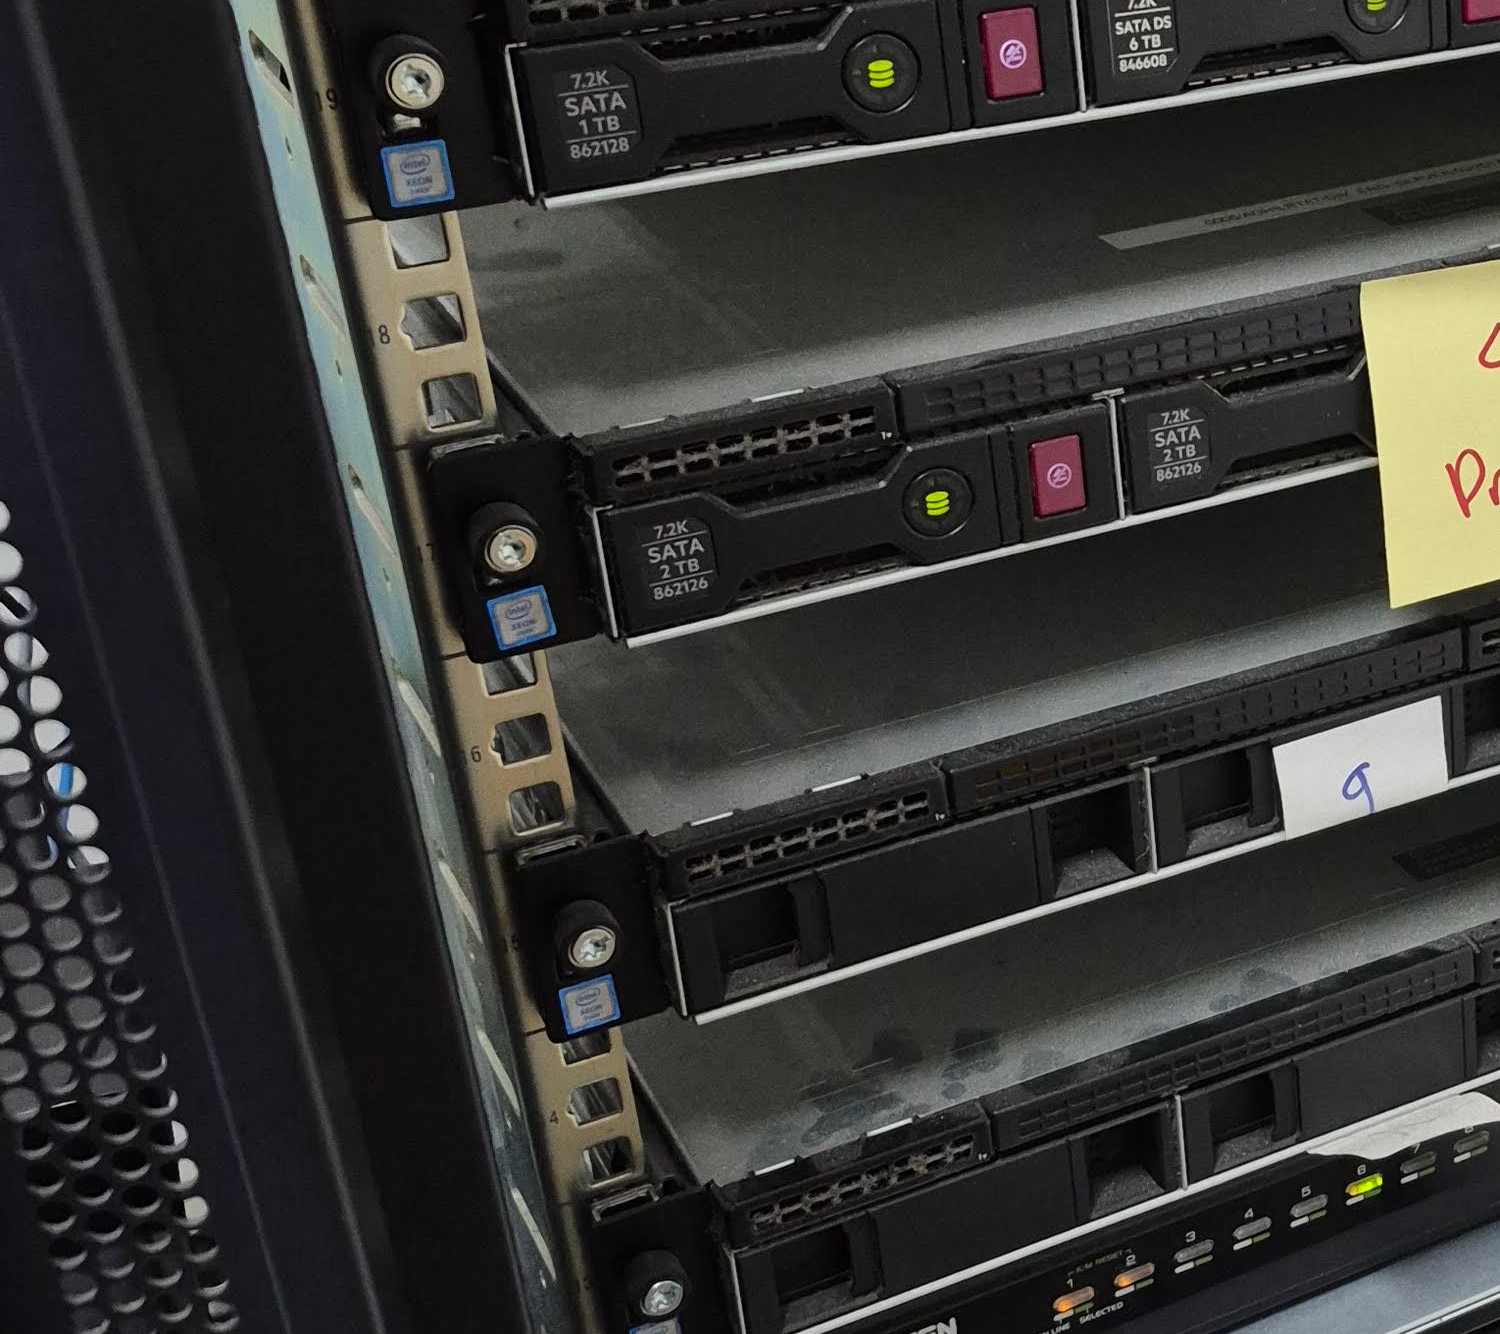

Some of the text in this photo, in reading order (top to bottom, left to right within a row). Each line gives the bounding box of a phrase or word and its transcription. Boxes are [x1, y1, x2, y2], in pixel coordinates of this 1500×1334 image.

[1115, 15, 1172, 35] SATA DS
[1129, 33, 1161, 51] 6 TB
[1119, 54, 1167, 73] 846608
[570, 69, 610, 89] 7.2K
[564, 91, 627, 117] SATA
[578, 115, 621, 135] 1 TB
[569, 137, 630, 159] 862128
[1160, 408, 1191, 425] 7.2K
[1154, 425, 1202, 448] SATA
[1163, 443, 1197, 463] 2 TB
[1156, 461, 1202, 482] 862126
[653, 519, 690, 539] 7.2K
[647, 537, 706, 564] SATA
[660, 557, 700, 579] 2 TB
[653, 576, 709, 600] 862126
[1356, 1163, 1367, 1176] 6
[1301, 1185, 1312, 1197] 5
[1243, 1207, 1254, 1219] 4
[1185, 1230, 1196, 1243] 3
[1125, 1254, 1137, 1267] 2
[1066, 1277, 1074, 1288] 1
[1079, 1301, 1124, 1325] SELECTED
